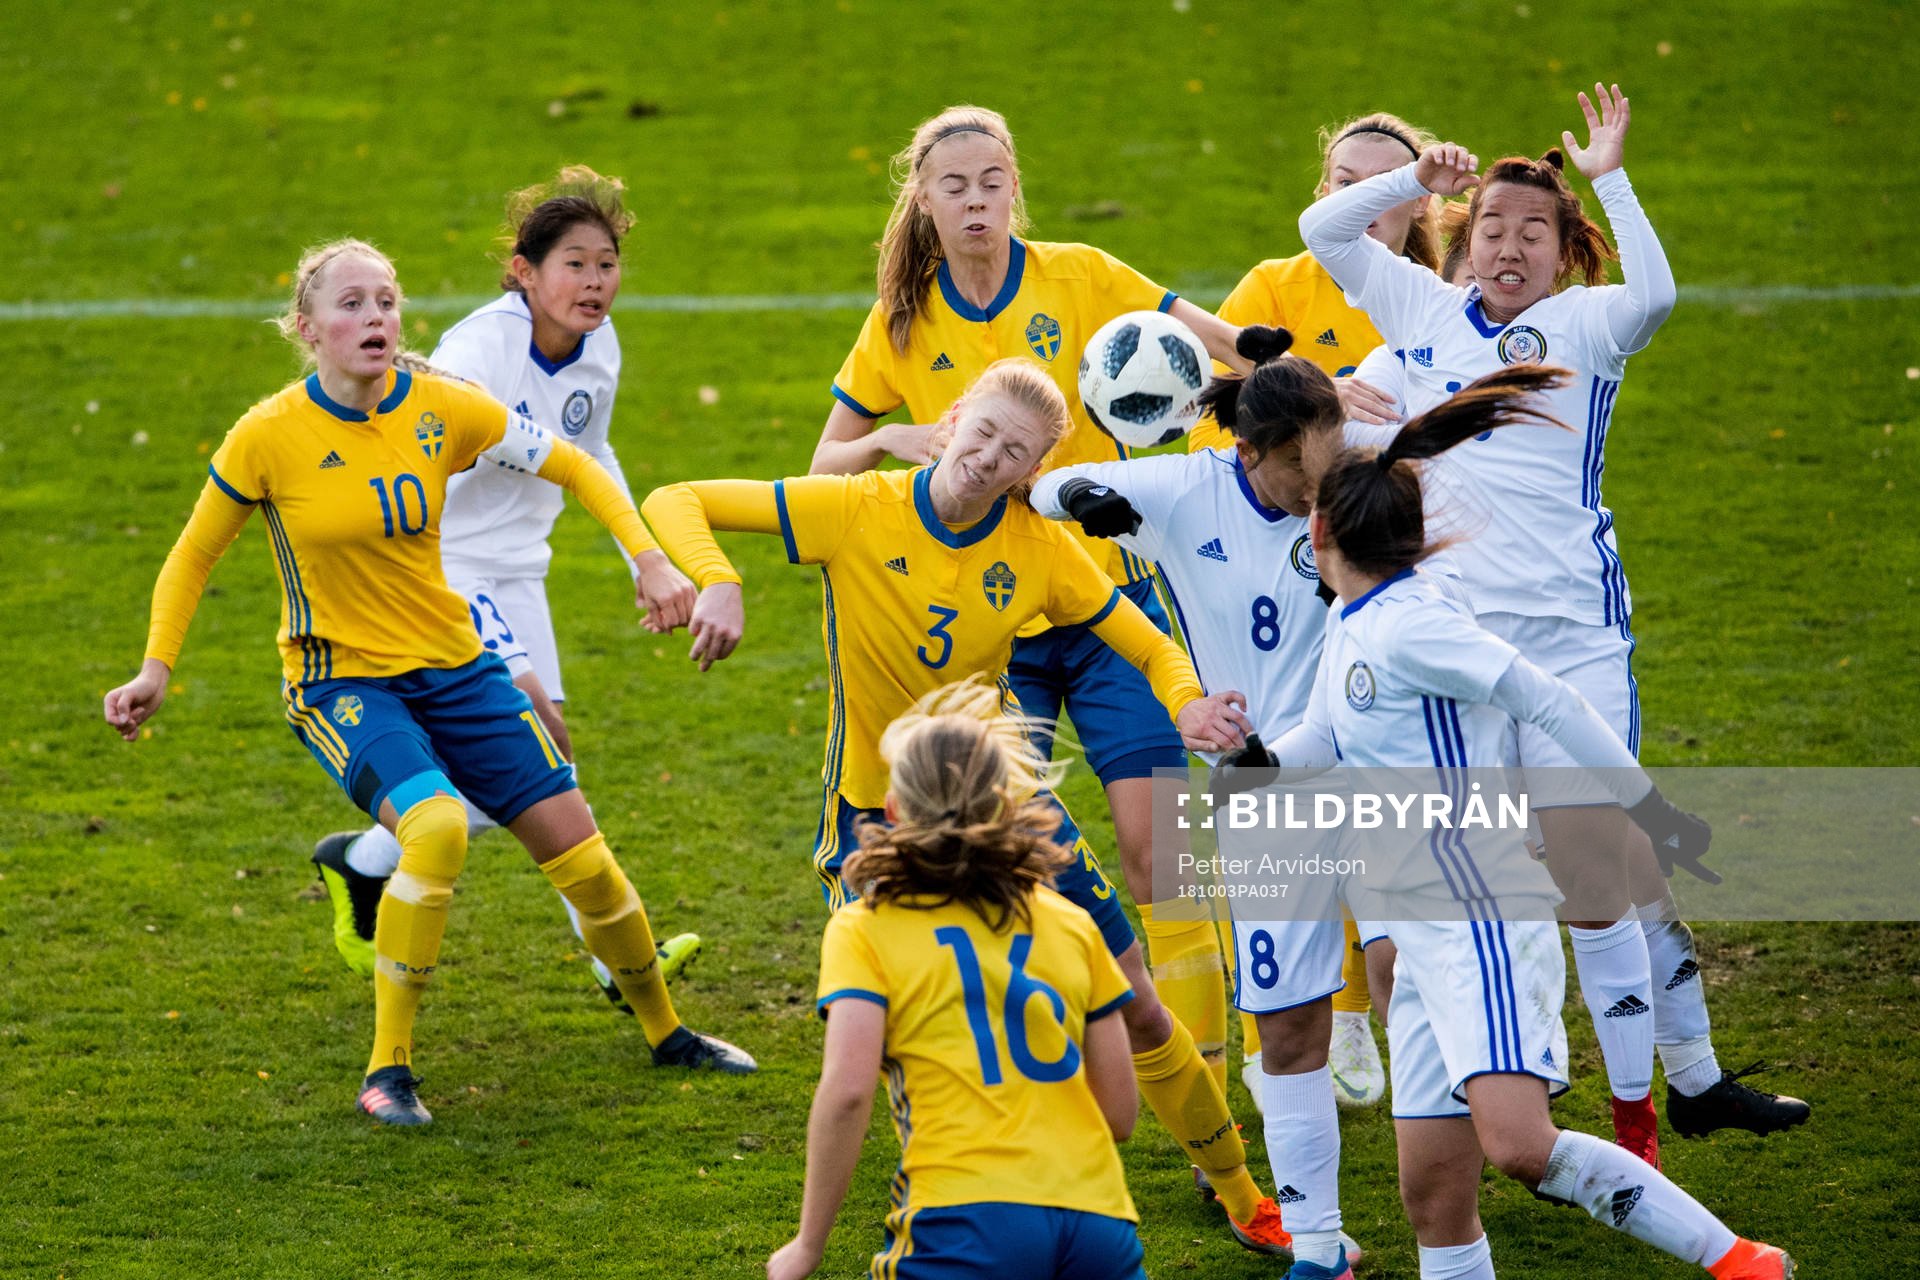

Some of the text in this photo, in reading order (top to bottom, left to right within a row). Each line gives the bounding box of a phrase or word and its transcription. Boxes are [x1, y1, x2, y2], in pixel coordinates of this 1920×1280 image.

[1315, 338, 1339, 347] adidas
[930, 362, 954, 371] adidas
[1407, 350, 1434, 368] adidas
[319, 460, 346, 469] adidas
[369, 473, 428, 538] 10
[885, 561, 909, 576] adidas
[1196, 548, 1228, 562] adidas
[917, 604, 959, 670] 3
[1251, 595, 1281, 652] 8
[1072, 836, 1111, 900] 3
[1249, 929, 1280, 990] 8
[934, 926, 1082, 1086] 16
[1604, 1004, 1650, 1018] adidas
[1614, 1184, 1645, 1228] adidas
